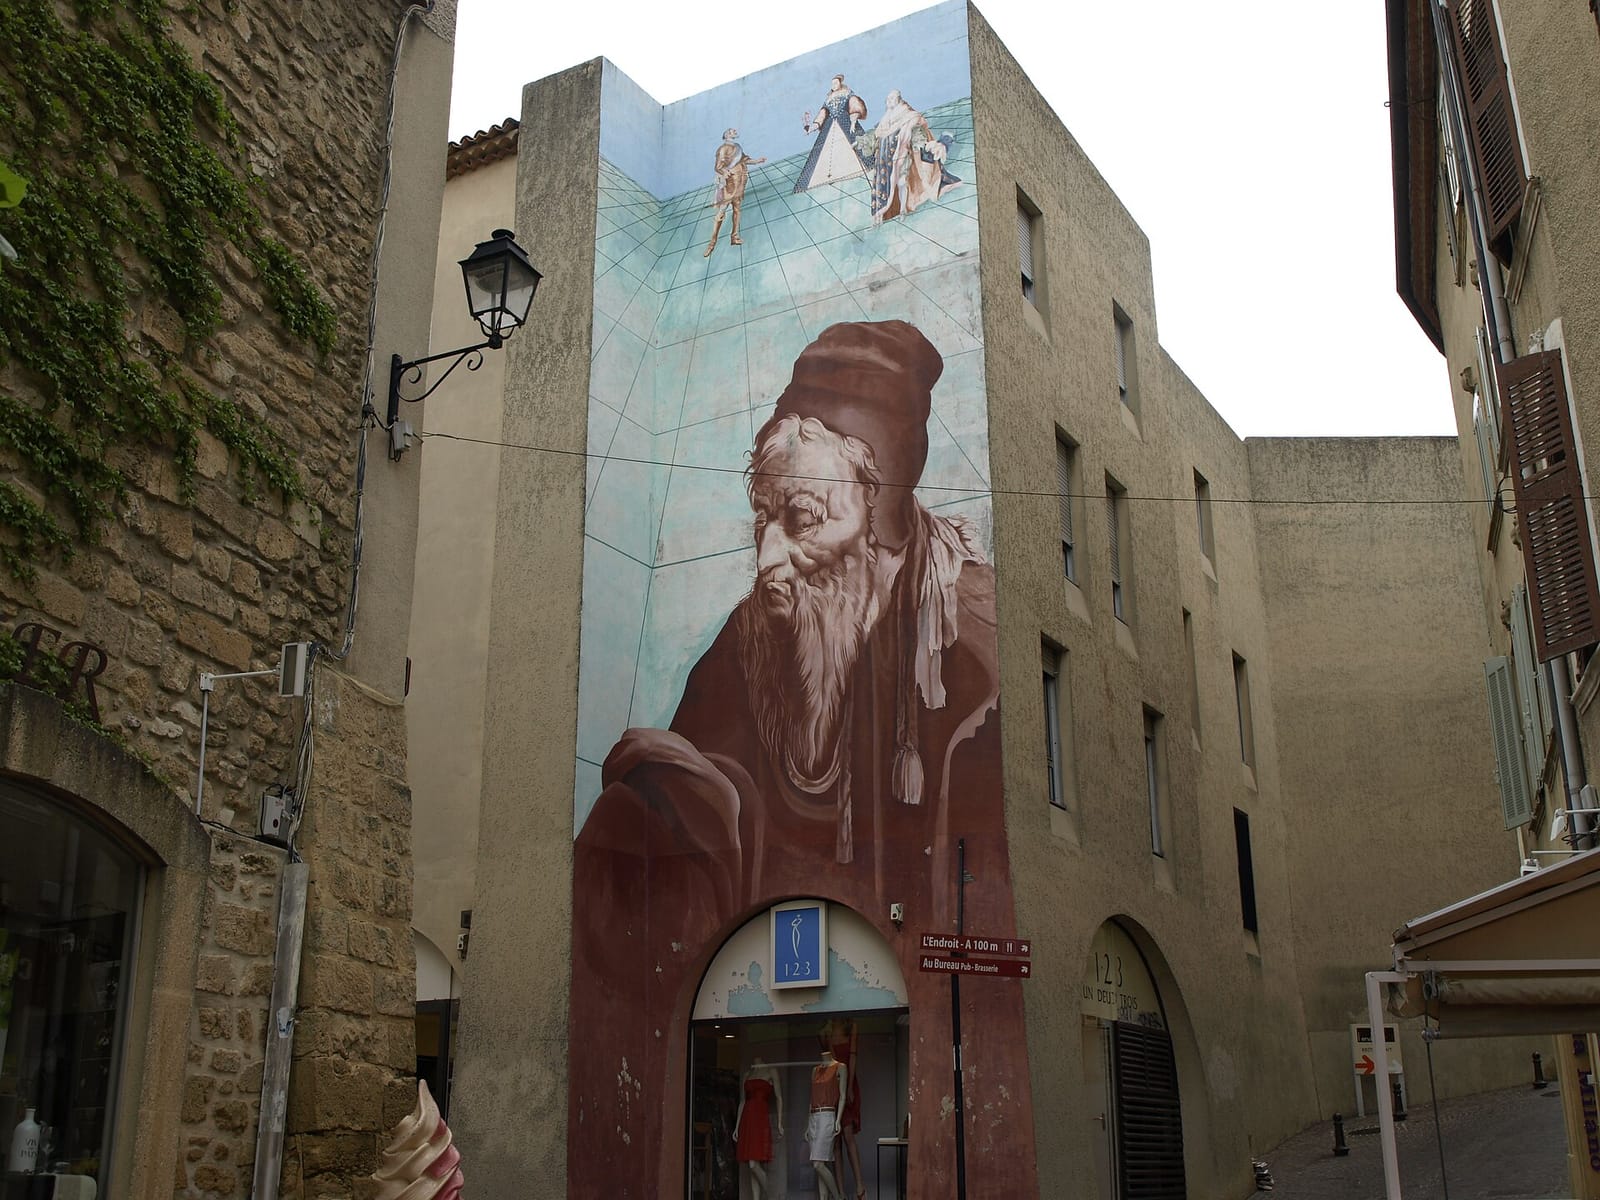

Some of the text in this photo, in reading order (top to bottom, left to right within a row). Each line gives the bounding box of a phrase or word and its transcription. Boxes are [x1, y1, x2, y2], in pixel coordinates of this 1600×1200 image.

[922, 936, 959, 949] L'Endroit
[964, 939, 972, 950] A
[974, 940, 989, 951] 100
[990, 943, 998, 952] m
[922, 958, 933, 968] Au
[934, 958, 960, 970] Bureau
[960, 963, 971, 971] Pub
[974, 963, 999, 973] Brasserie
[1577, 1068, 1600, 1173] Milano
